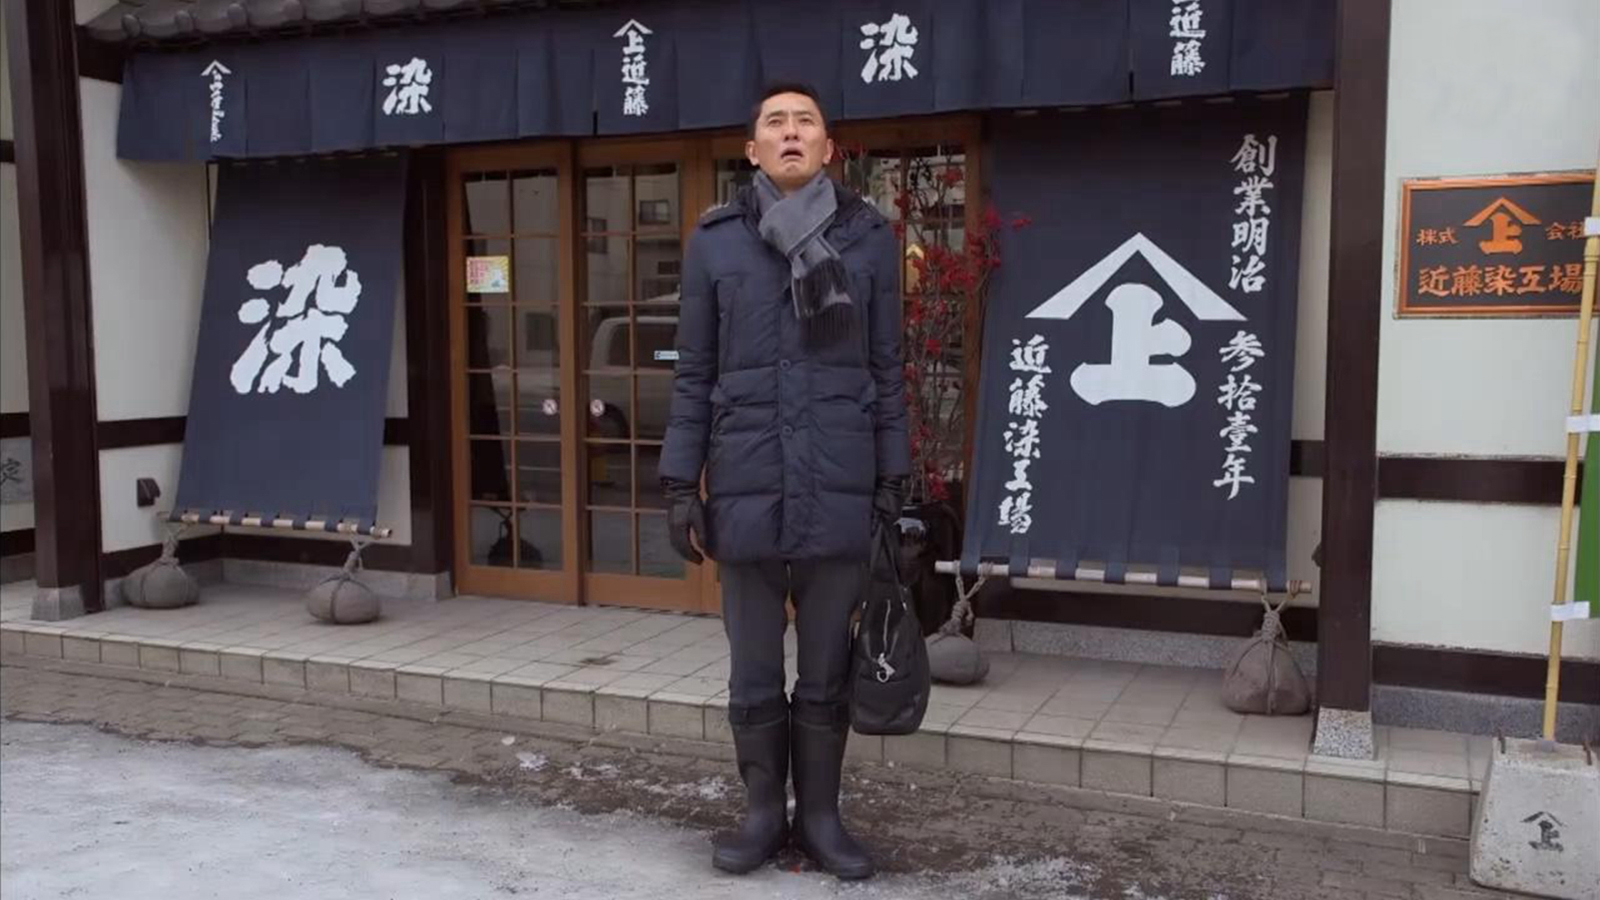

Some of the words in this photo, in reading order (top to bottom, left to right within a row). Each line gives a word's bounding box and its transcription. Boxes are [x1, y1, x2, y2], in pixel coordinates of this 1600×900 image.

[382, 58, 433, 115] 染
[621, 29, 650, 116] 上近藤
[859, 14, 919, 83] 染
[1228, 133, 1278, 294] 創業明治
[1416, 227, 1460, 246] 株式
[1475, 212, 1523, 254] 上
[230, 243, 362, 395] 染
[1070, 283, 1197, 408] 上
[998, 334, 1052, 534] 近藤染工場
